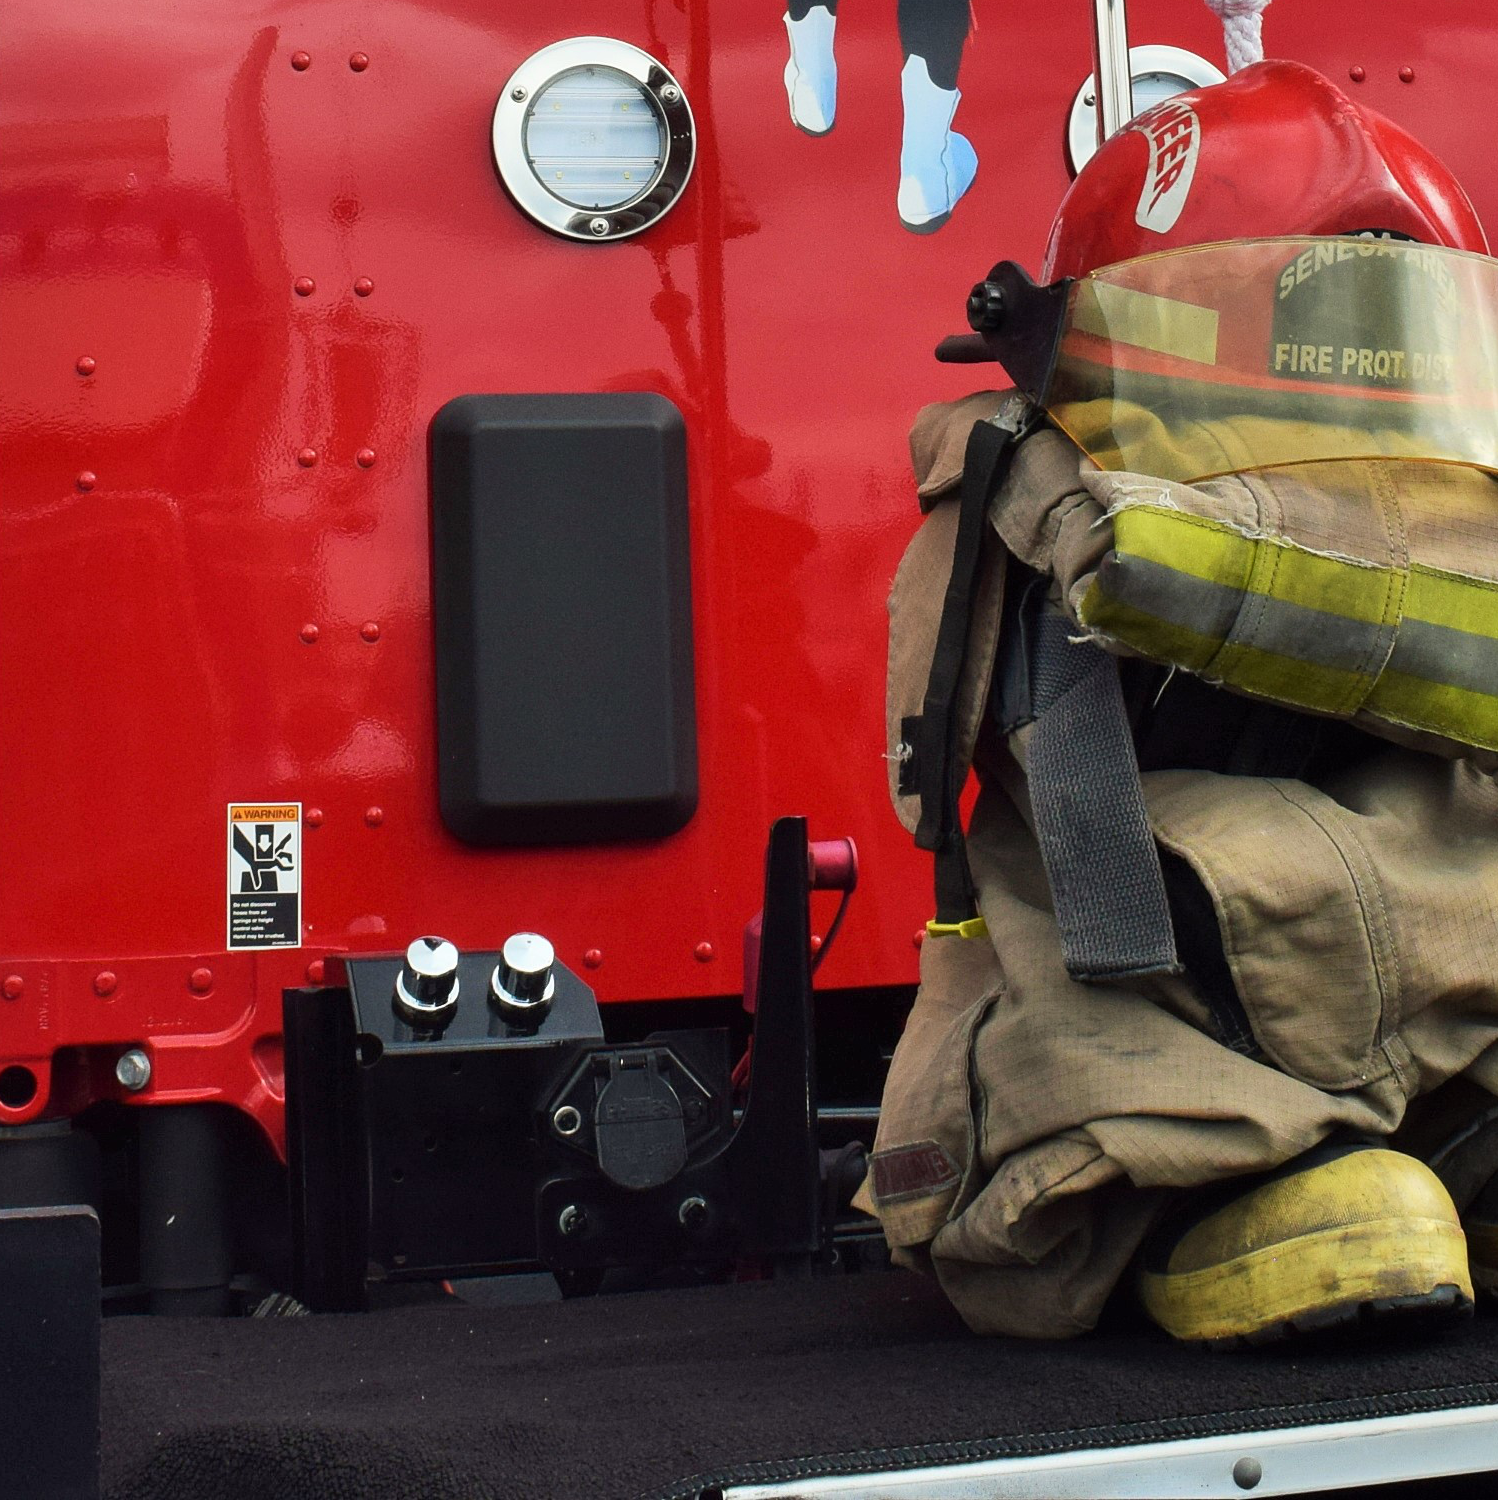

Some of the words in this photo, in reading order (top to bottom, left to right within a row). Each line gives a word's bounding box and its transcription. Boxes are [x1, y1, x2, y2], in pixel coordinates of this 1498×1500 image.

[1279, 231, 1397, 300] SENECA
[1274, 343, 1334, 375] FIRE
[244, 808, 296, 819] WARNING
